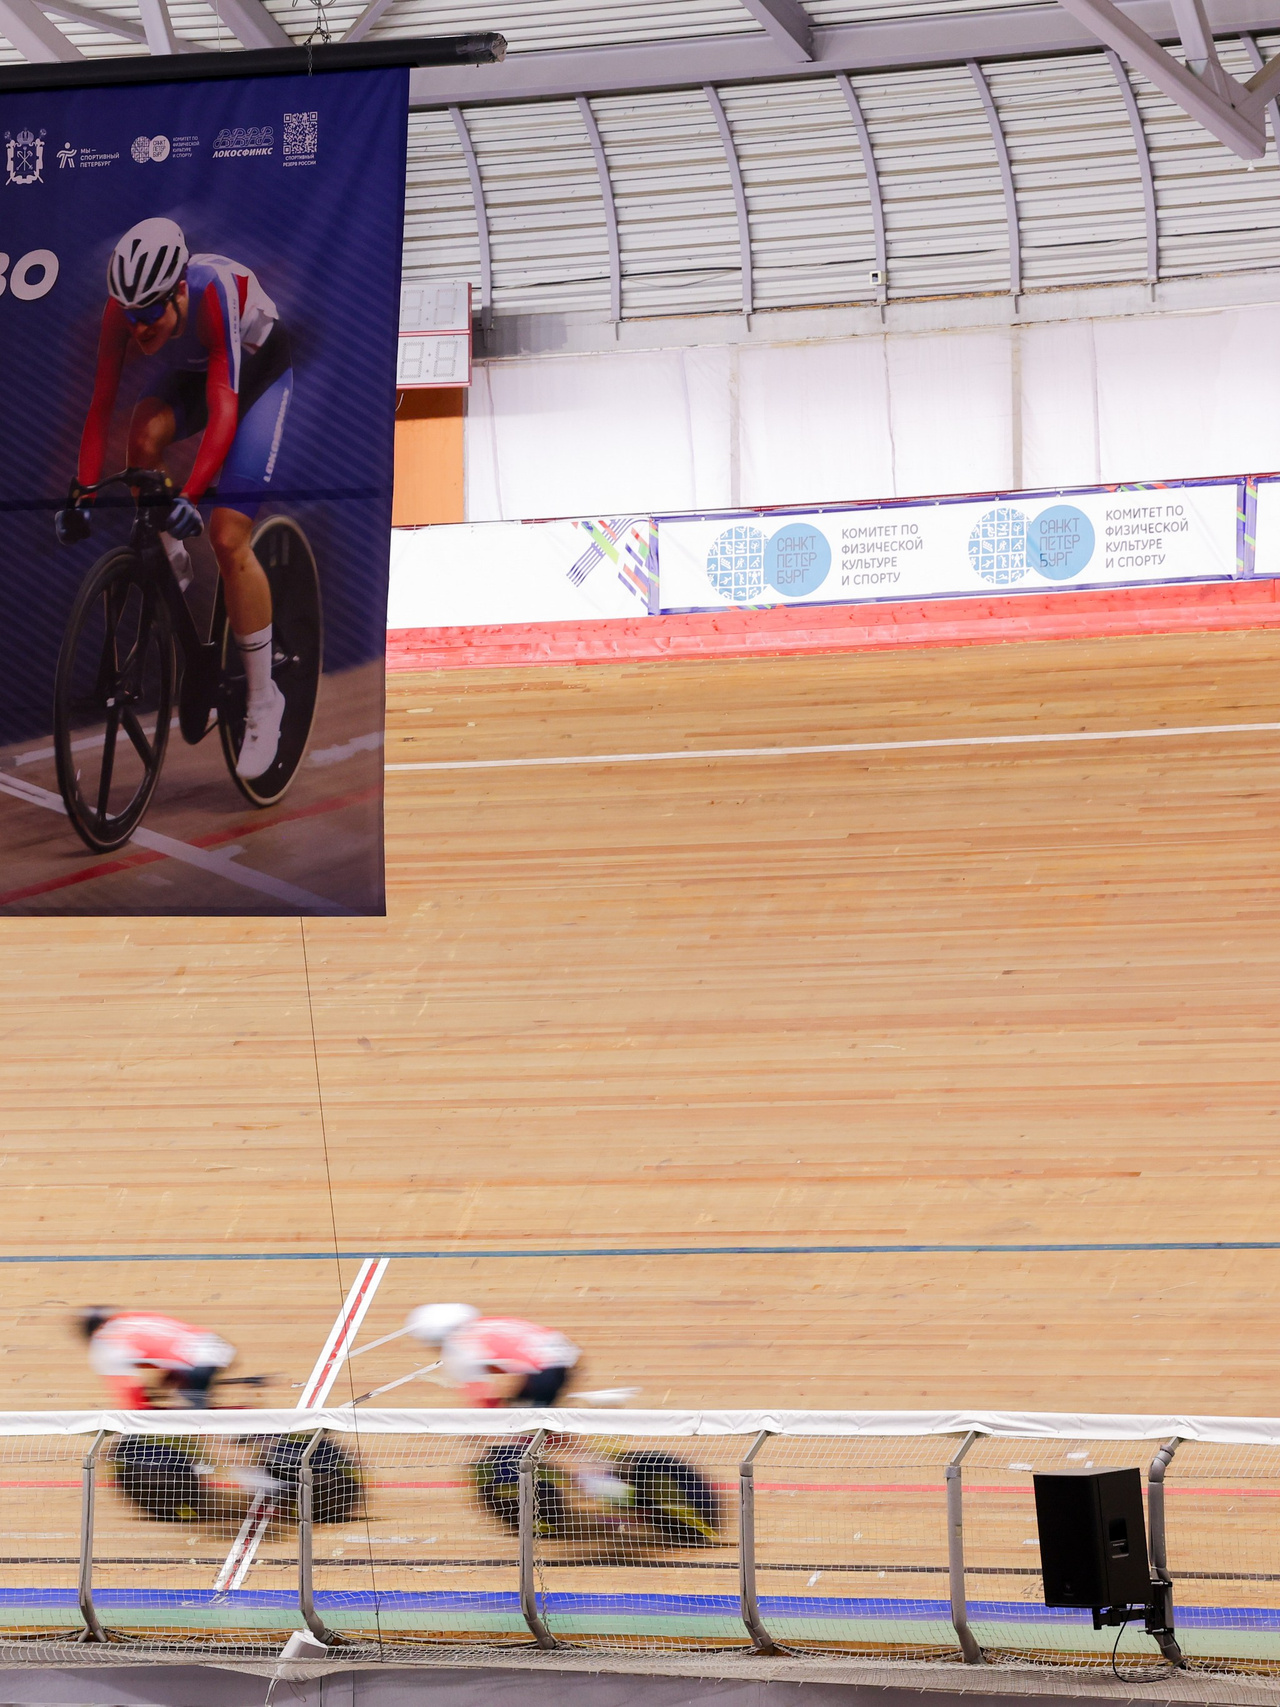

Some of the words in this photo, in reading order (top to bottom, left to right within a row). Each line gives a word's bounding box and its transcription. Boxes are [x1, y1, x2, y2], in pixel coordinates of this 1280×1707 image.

[80, 152, 120, 161] СПОРТИВНЫЙ
[212, 147, 274, 159] ЛОКОСФИНКС
[80, 160, 111, 168] ПЕТЕРБУРГ
[1106, 506, 1163, 521] КОМИТЕТ
[1166, 505, 1184, 517] ПО
[842, 524, 898, 540] КОМИТЕТ
[901, 524, 919, 536] ПО
[1039, 518, 1080, 534] САНКТ
[1105, 518, 1189, 537] ФИЗИЧЕСКОЙ
[776, 536, 816, 552] САНКТ
[841, 536, 924, 554] ФИЗИЧЕСКОЙ
[1039, 534, 1080, 552] ПЕТЕР
[1106, 538, 1163, 553] КУЛЬТУРЕ
[776, 552, 818, 568] ПЕТЕР
[842, 556, 898, 570] КУЛЬТУРЕ
[1039, 552, 1073, 568] БУРГ
[1106, 558, 1114, 568] И
[1118, 554, 1166, 568] СПОРТУ
[776, 568, 810, 585] БУРГ
[842, 576, 850, 586] И
[854, 572, 901, 585] СПОРТУ
